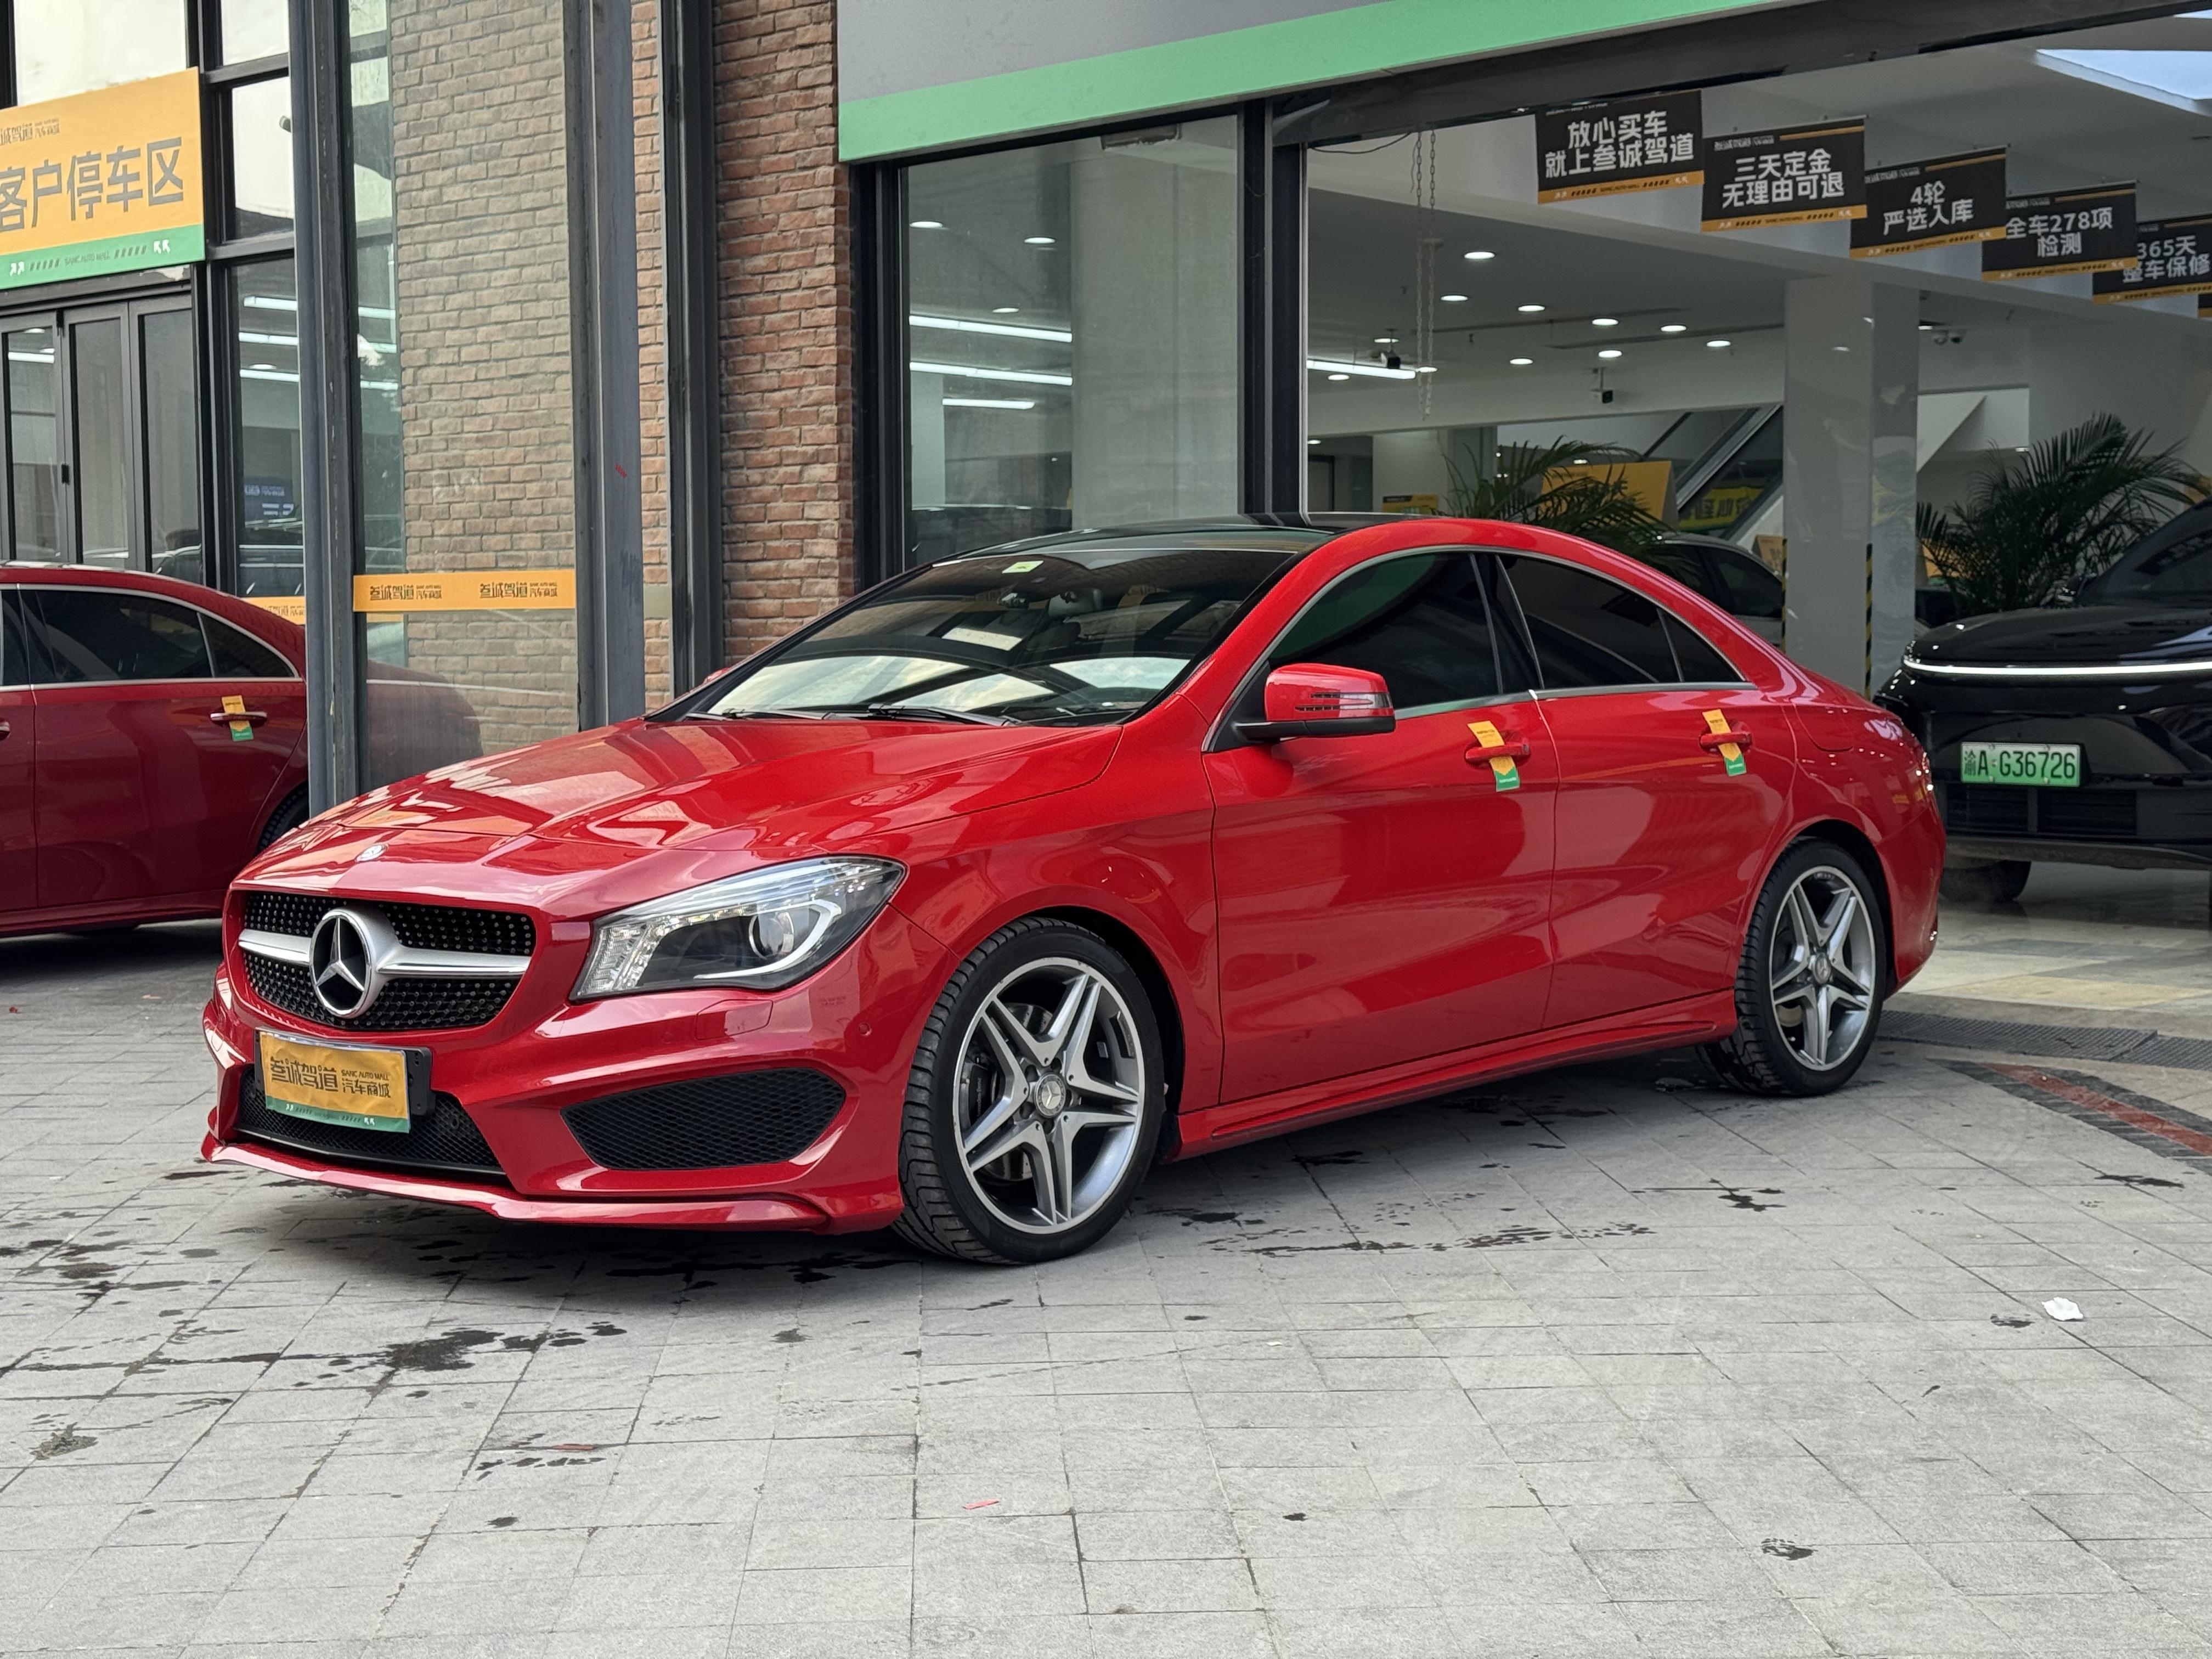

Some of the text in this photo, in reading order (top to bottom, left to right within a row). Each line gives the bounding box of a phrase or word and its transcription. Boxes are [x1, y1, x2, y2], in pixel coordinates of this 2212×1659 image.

[1567, 110, 1667, 149] 放心买车
[1545, 133, 1694, 178] 就上叁诚驾道
[1734, 148, 1831, 183] 三天定金
[0, 137, 183, 233] 客户停车区
[1722, 171, 1844, 208] 无理由可退
[1910, 180, 1945, 205] 4轮
[1883, 198, 1974, 235] 严选入库
[2006, 207, 2113, 240] 全车278项
[2037, 233, 2082, 258] 检测
[2137, 235, 2196, 259] 365天
[270, 1056, 338, 1092] 叁诚驾道
[342, 1077, 391, 1098] 汽车商城
[359, 1070, 374, 1079] AUTO
[374, 1072, 389, 1081] MALL
